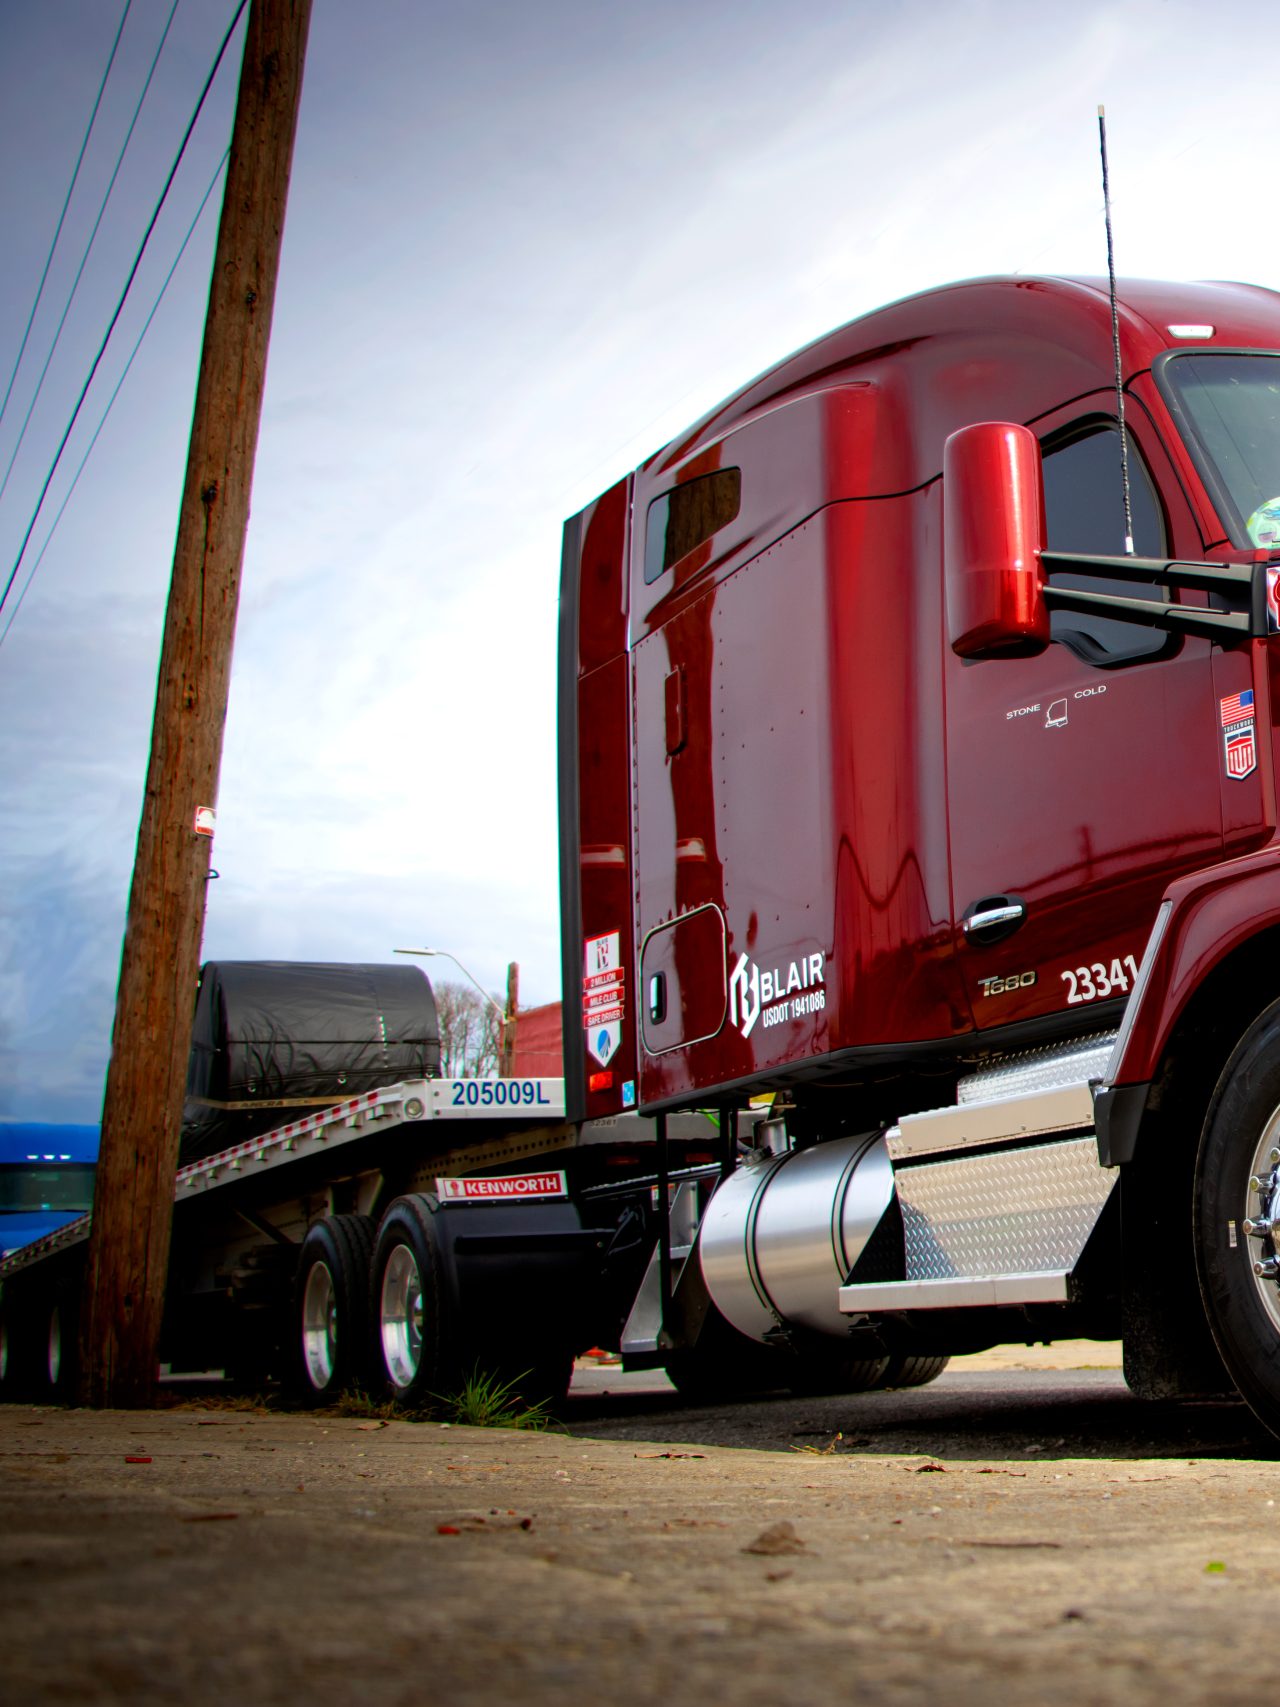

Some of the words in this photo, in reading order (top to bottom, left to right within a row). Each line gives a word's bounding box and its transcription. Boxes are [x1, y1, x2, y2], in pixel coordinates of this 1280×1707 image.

[1006, 704, 1041, 720] STONE
[1074, 685, 1107, 699] COLD
[595, 971, 616, 986] MILLION
[760, 952, 825, 1003] BLAIR
[977, 970, 1036, 997] T680
[1060, 954, 1138, 1004] 23341
[603, 991, 618, 1004] CLUB
[588, 1014, 601, 1027] SAFE
[763, 1002, 790, 1028] USDOT
[451, 1081, 551, 1105] 205009L
[465, 1176, 558, 1194] KENWORTH
